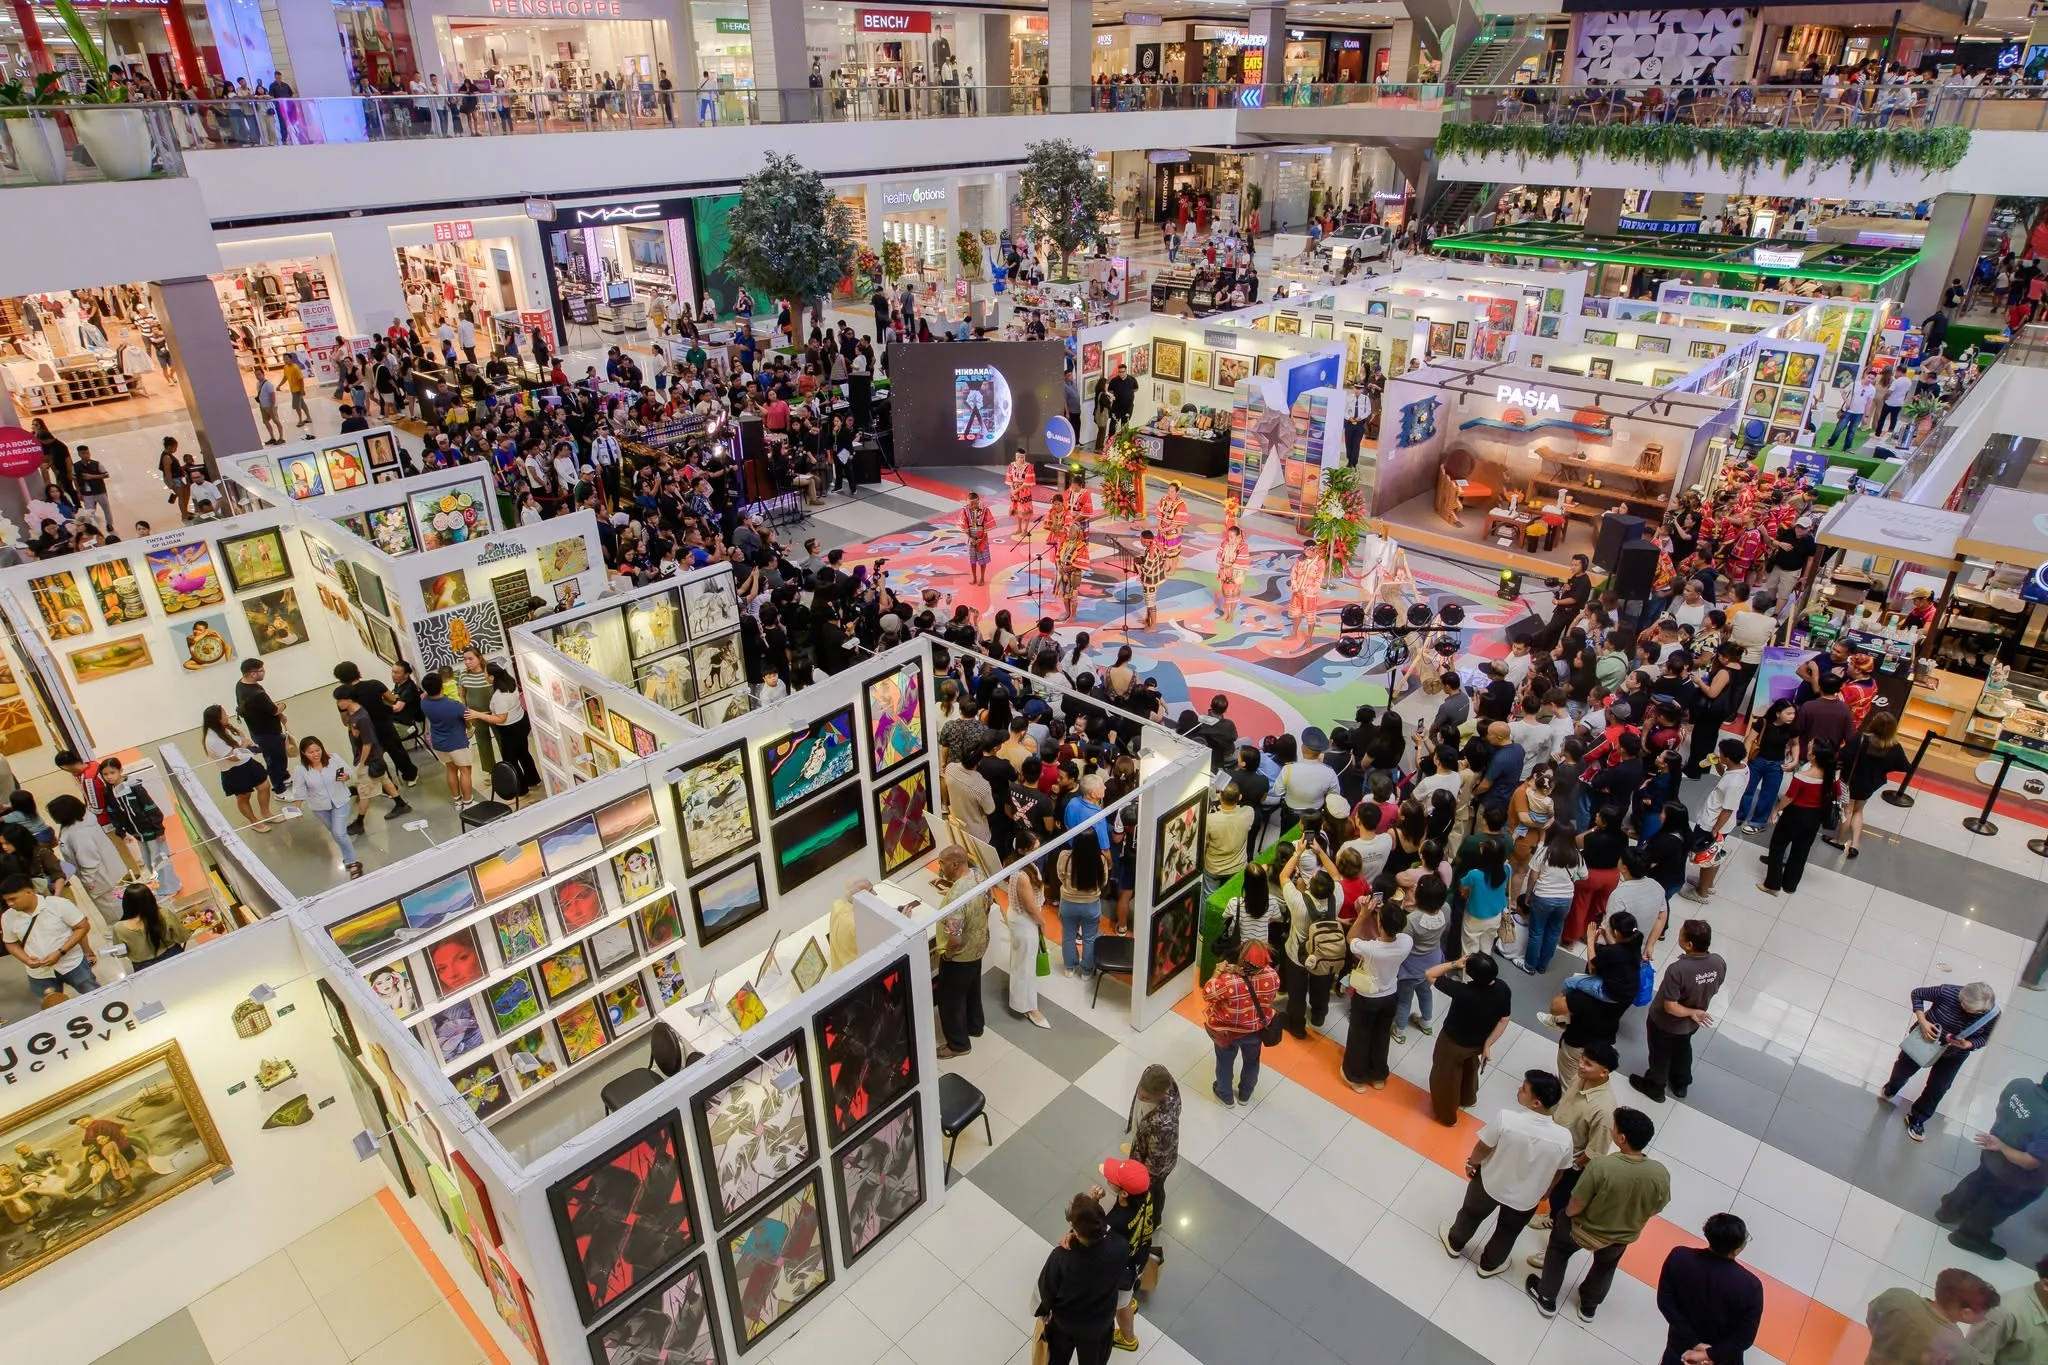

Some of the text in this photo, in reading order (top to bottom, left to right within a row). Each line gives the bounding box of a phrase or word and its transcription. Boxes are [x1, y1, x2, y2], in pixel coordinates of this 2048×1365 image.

[491, 0, 622, 15] PENSHOPPE
[1244, 57, 1262, 69] EATS
[1244, 70, 1261, 78] THIS
[883, 191, 912, 205] healthy
[456, 222, 470, 231] UNI
[1621, 219, 1658, 231] FRENCH
[1664, 222, 1696, 233] BAKER
[458, 230, 472, 239] QLO
[1496, 384, 1561, 413] PASIA
[477, 543, 526, 561] OCCIDENTAL
[4, 1019, 137, 1085] ECTIVE
